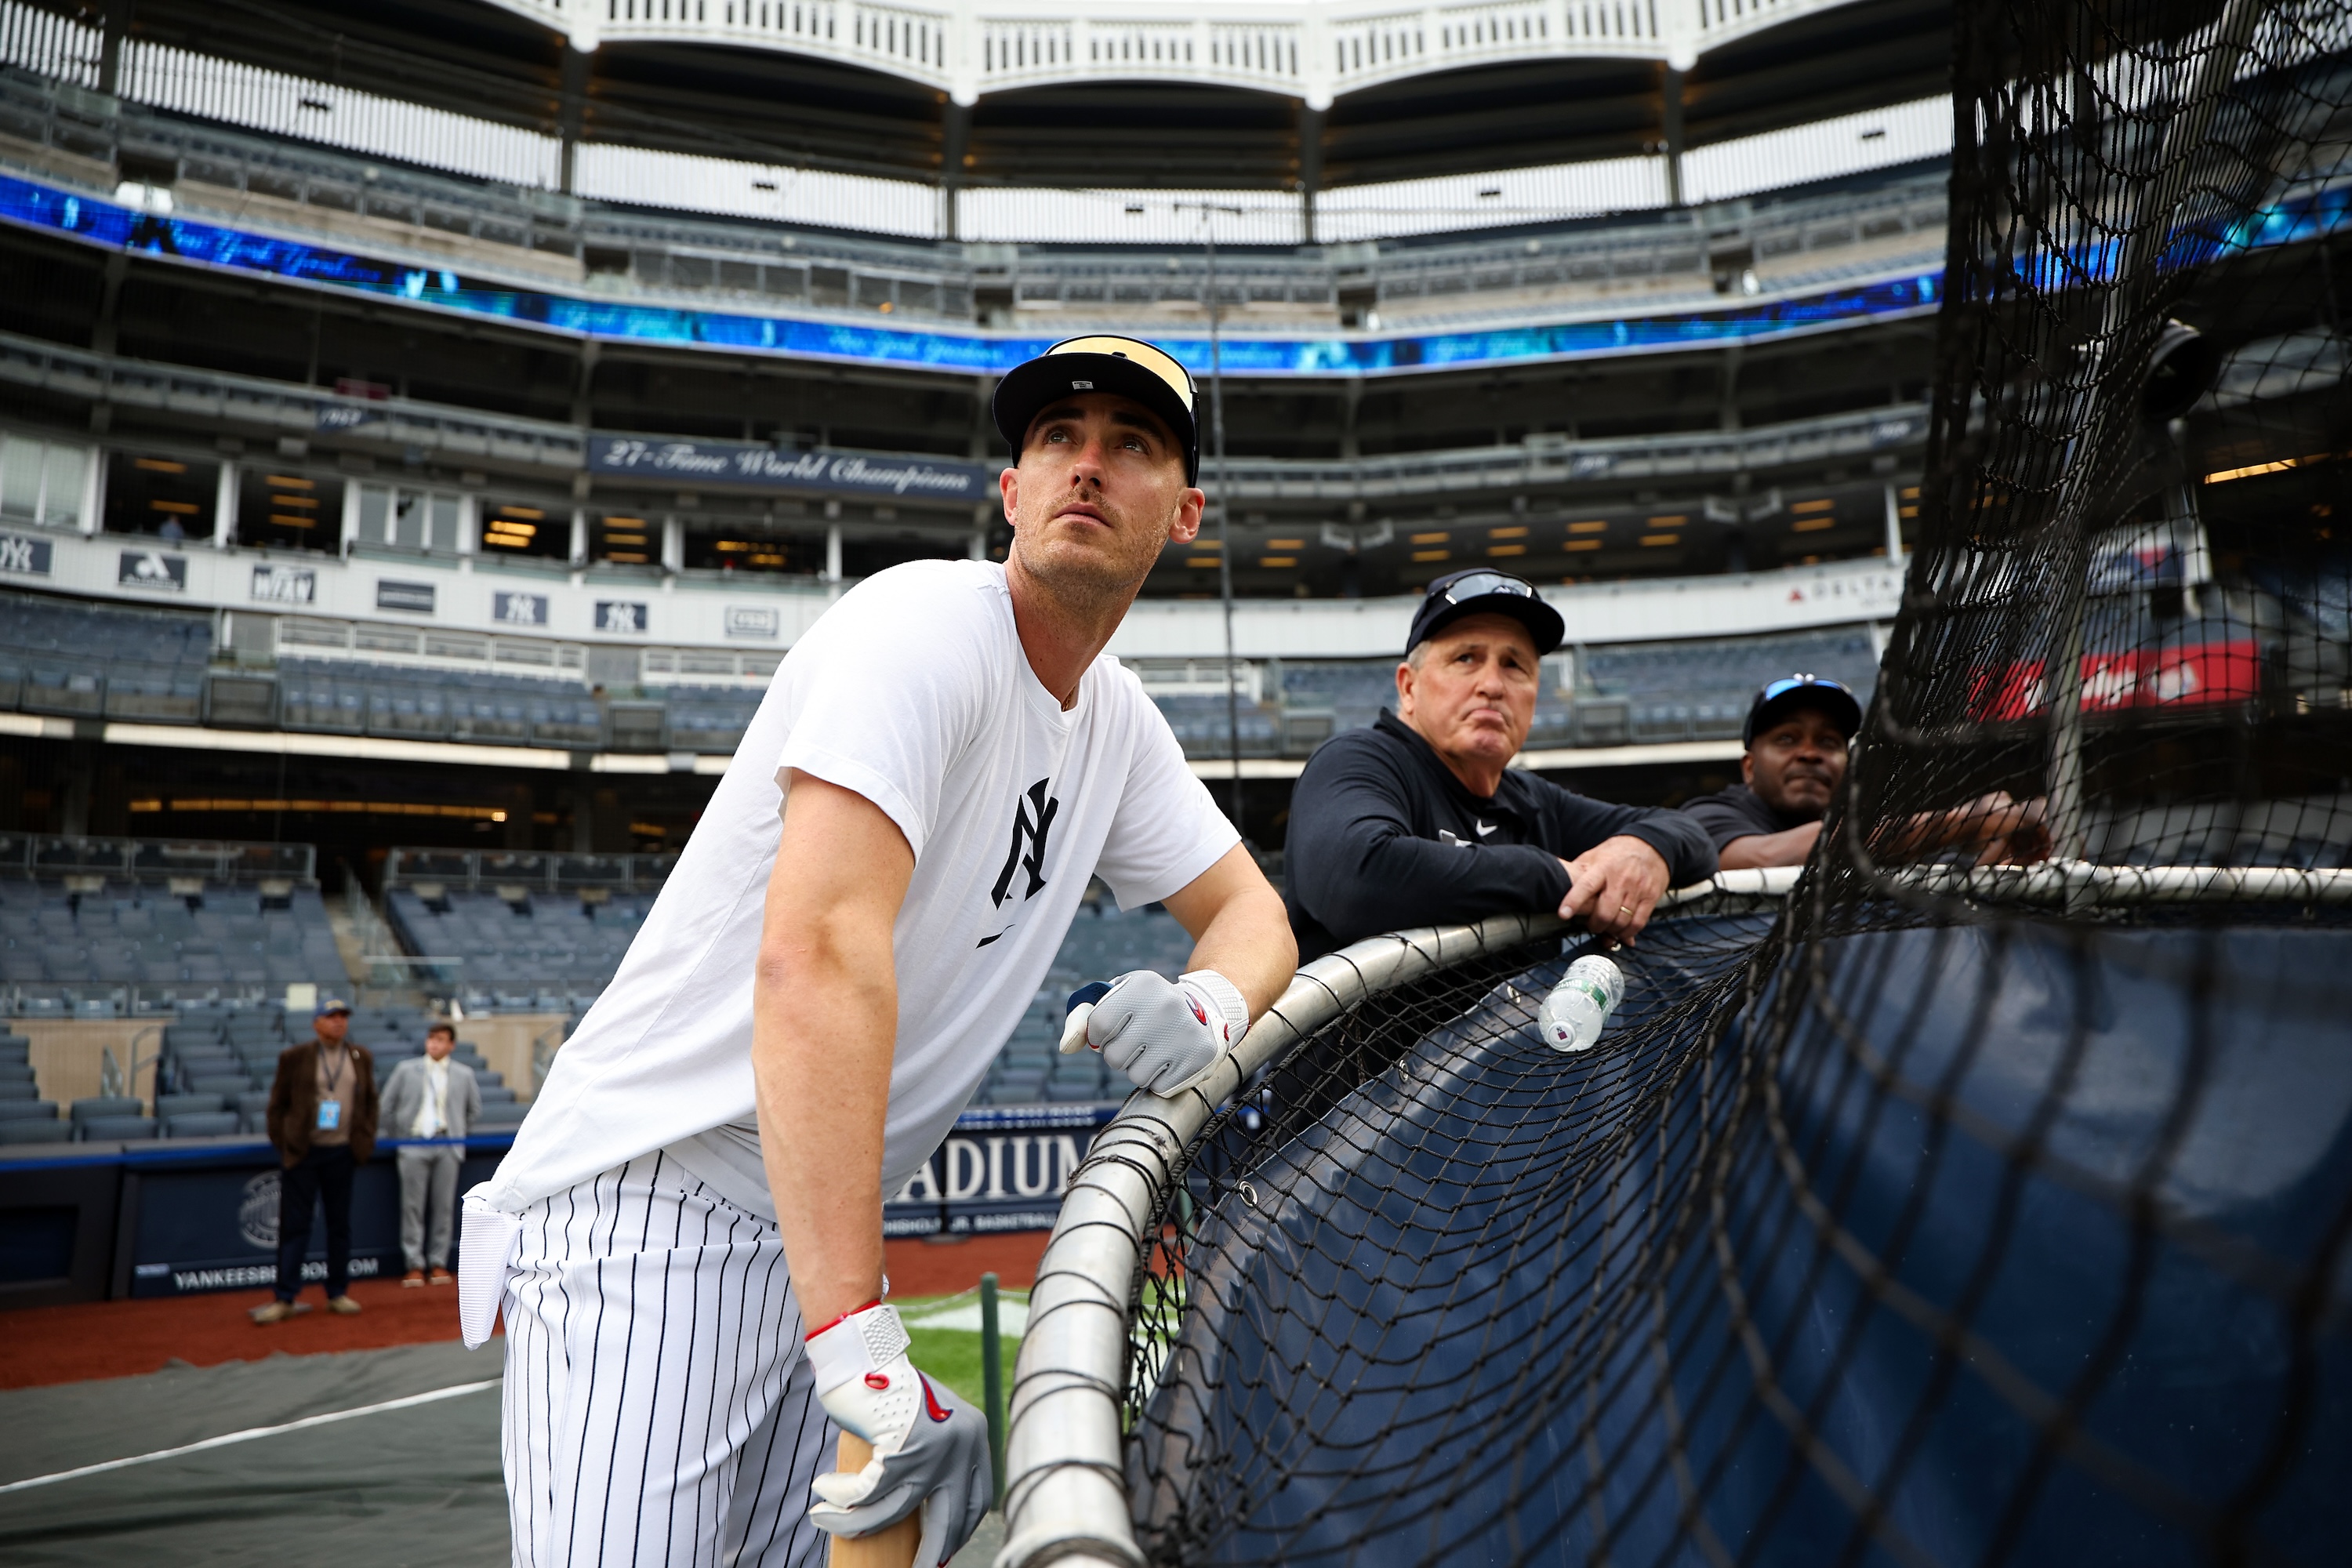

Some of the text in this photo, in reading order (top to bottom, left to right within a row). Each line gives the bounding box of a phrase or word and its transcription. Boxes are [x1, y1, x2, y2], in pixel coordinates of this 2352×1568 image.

[735, 449, 829, 481] World
[829, 457, 971, 494] Champions
[990, 776, 1059, 912] NY
[884, 1134, 1098, 1203] ADIUM
